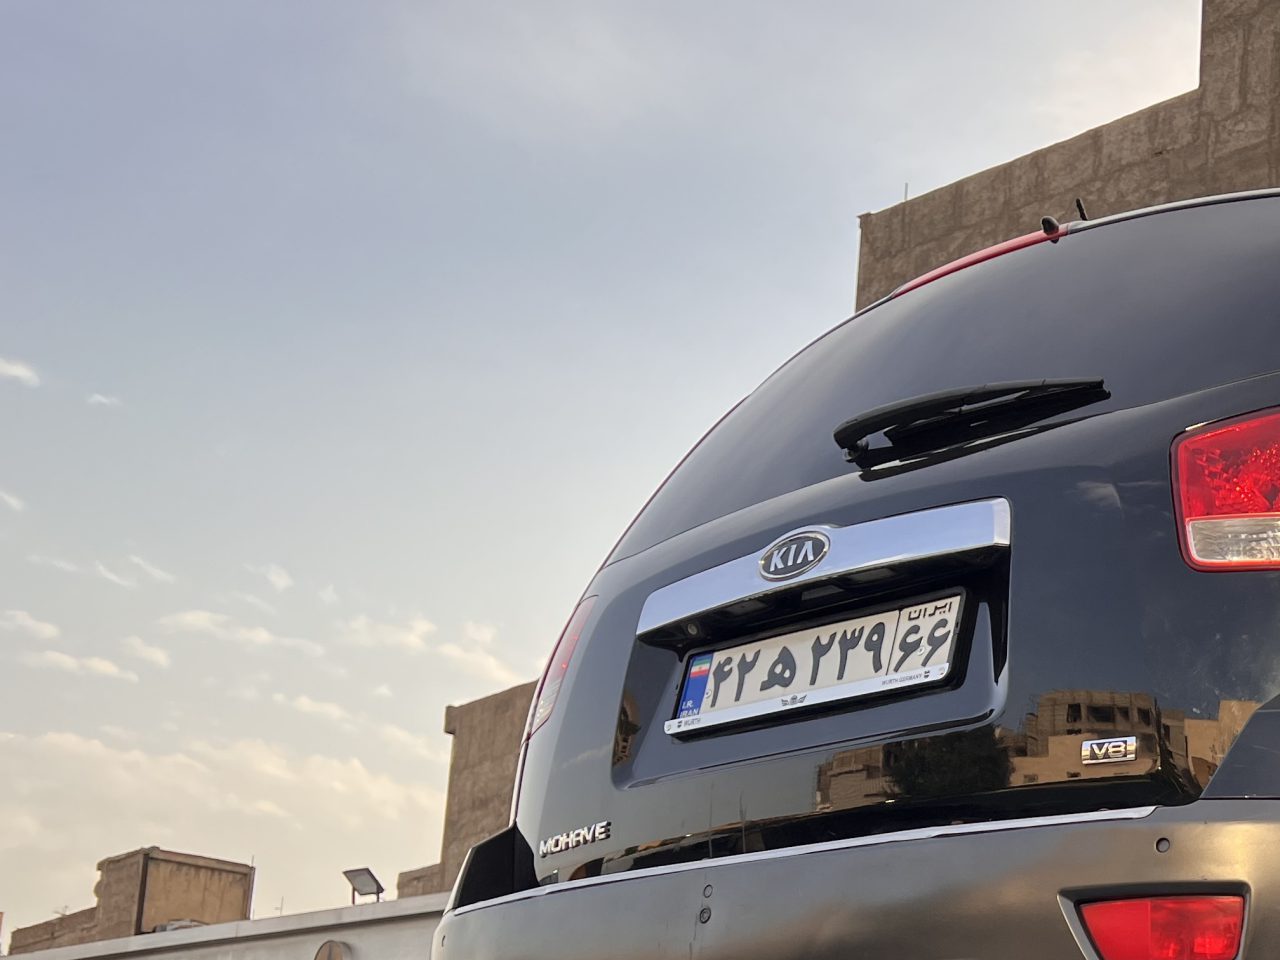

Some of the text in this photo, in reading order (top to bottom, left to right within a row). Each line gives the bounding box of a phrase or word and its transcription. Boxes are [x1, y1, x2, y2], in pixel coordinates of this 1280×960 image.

[769, 540, 815, 572] KIA
[1091, 741, 1126, 760] V8
[539, 820, 609, 856] MOHAVE
